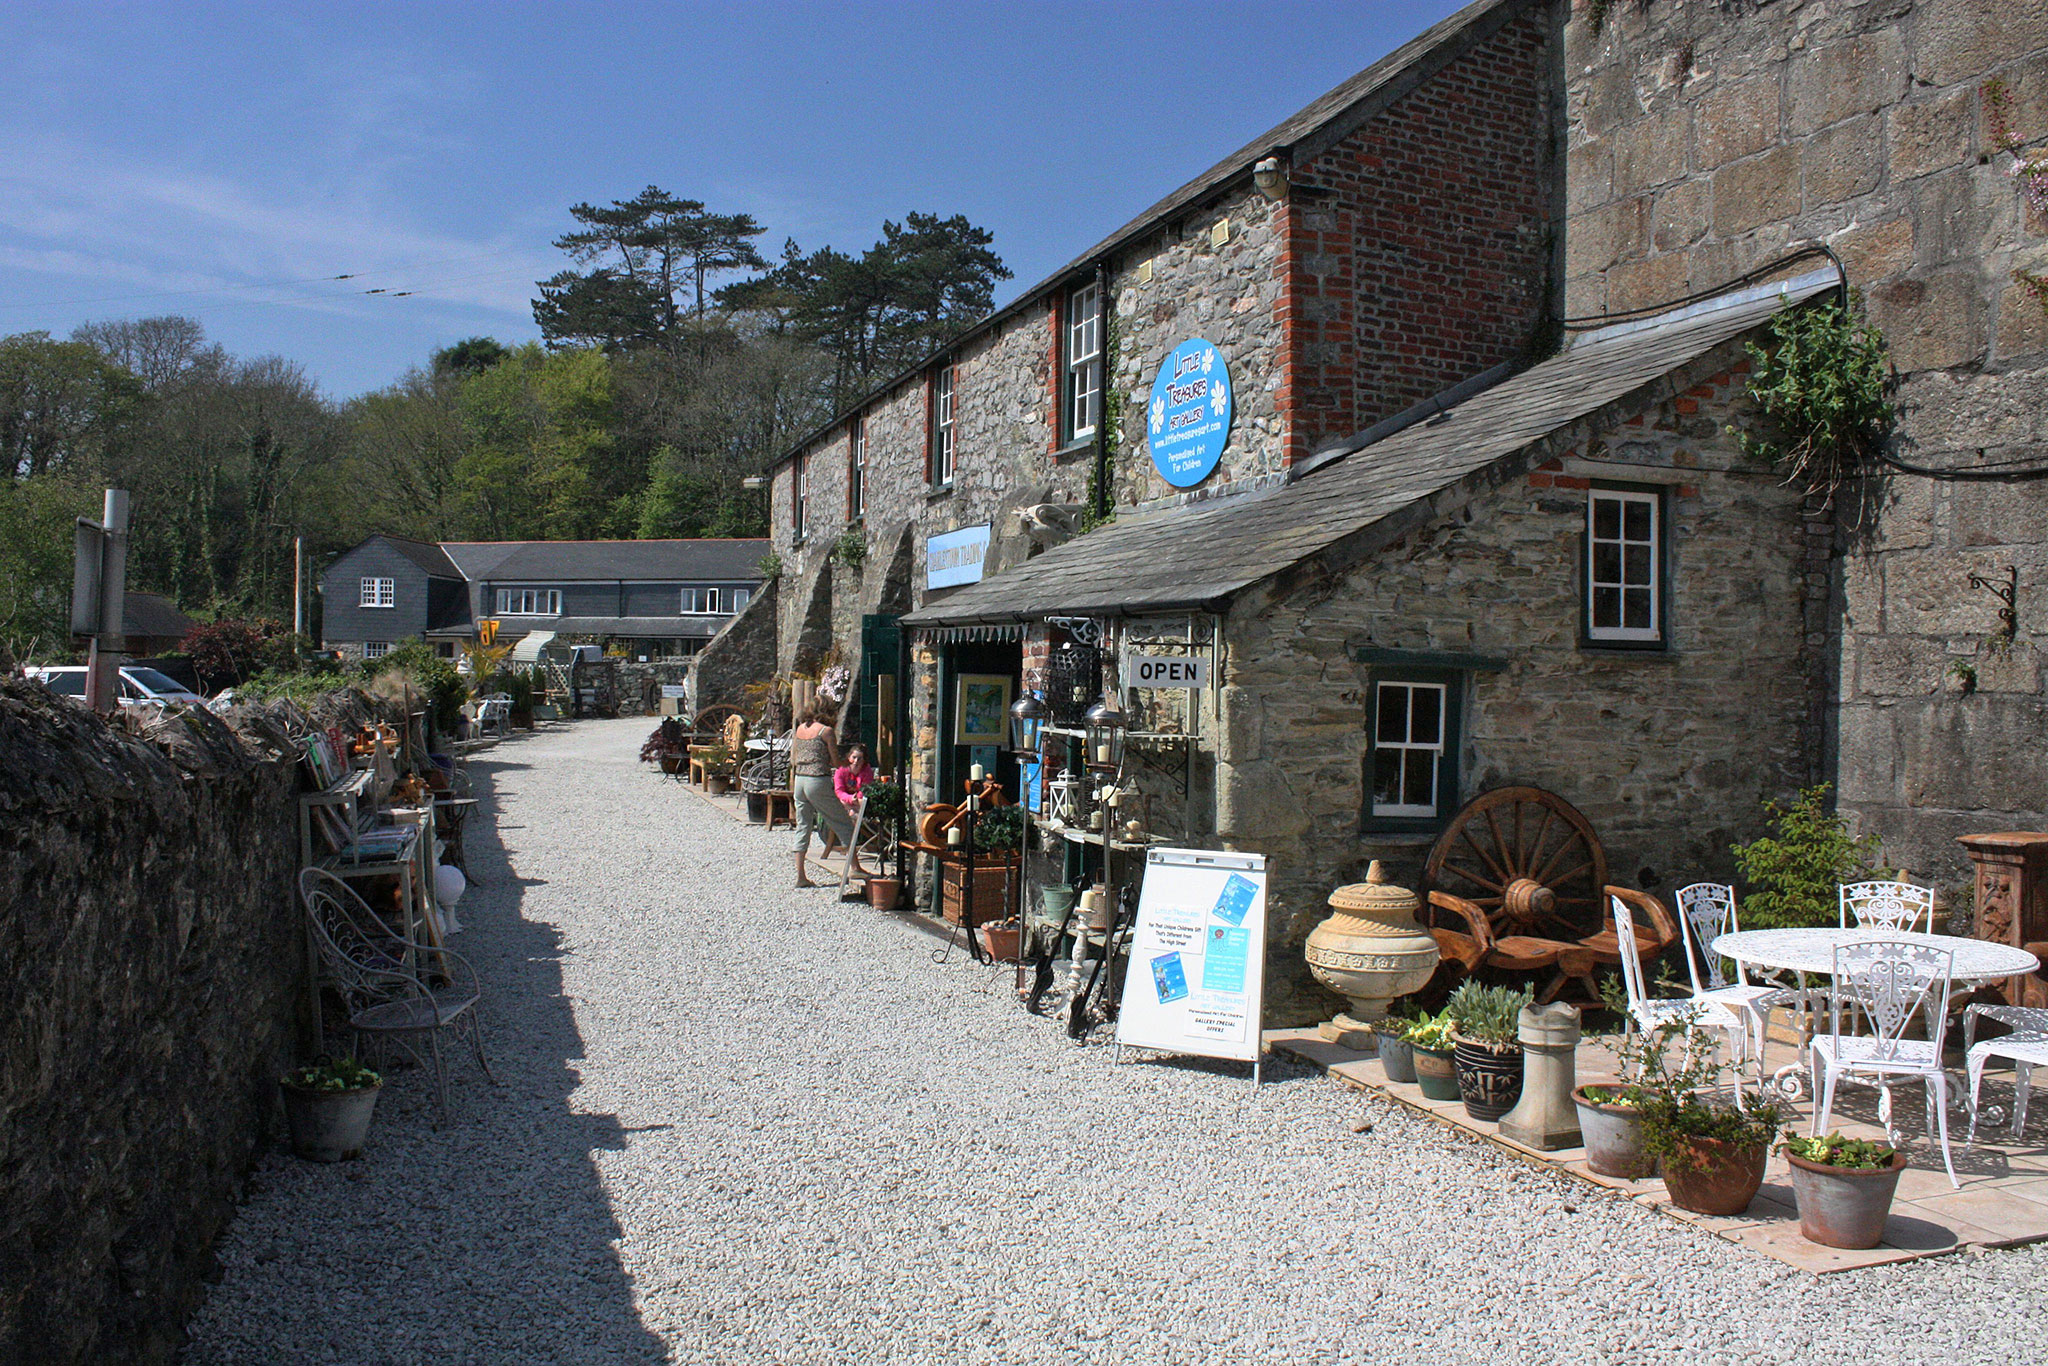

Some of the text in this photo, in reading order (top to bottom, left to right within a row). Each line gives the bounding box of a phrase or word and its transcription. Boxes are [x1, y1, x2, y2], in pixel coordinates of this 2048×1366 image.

[1140, 662, 1196, 680] OPEN
[1195, 1017, 1236, 1027] GALLERY SPECIAL
